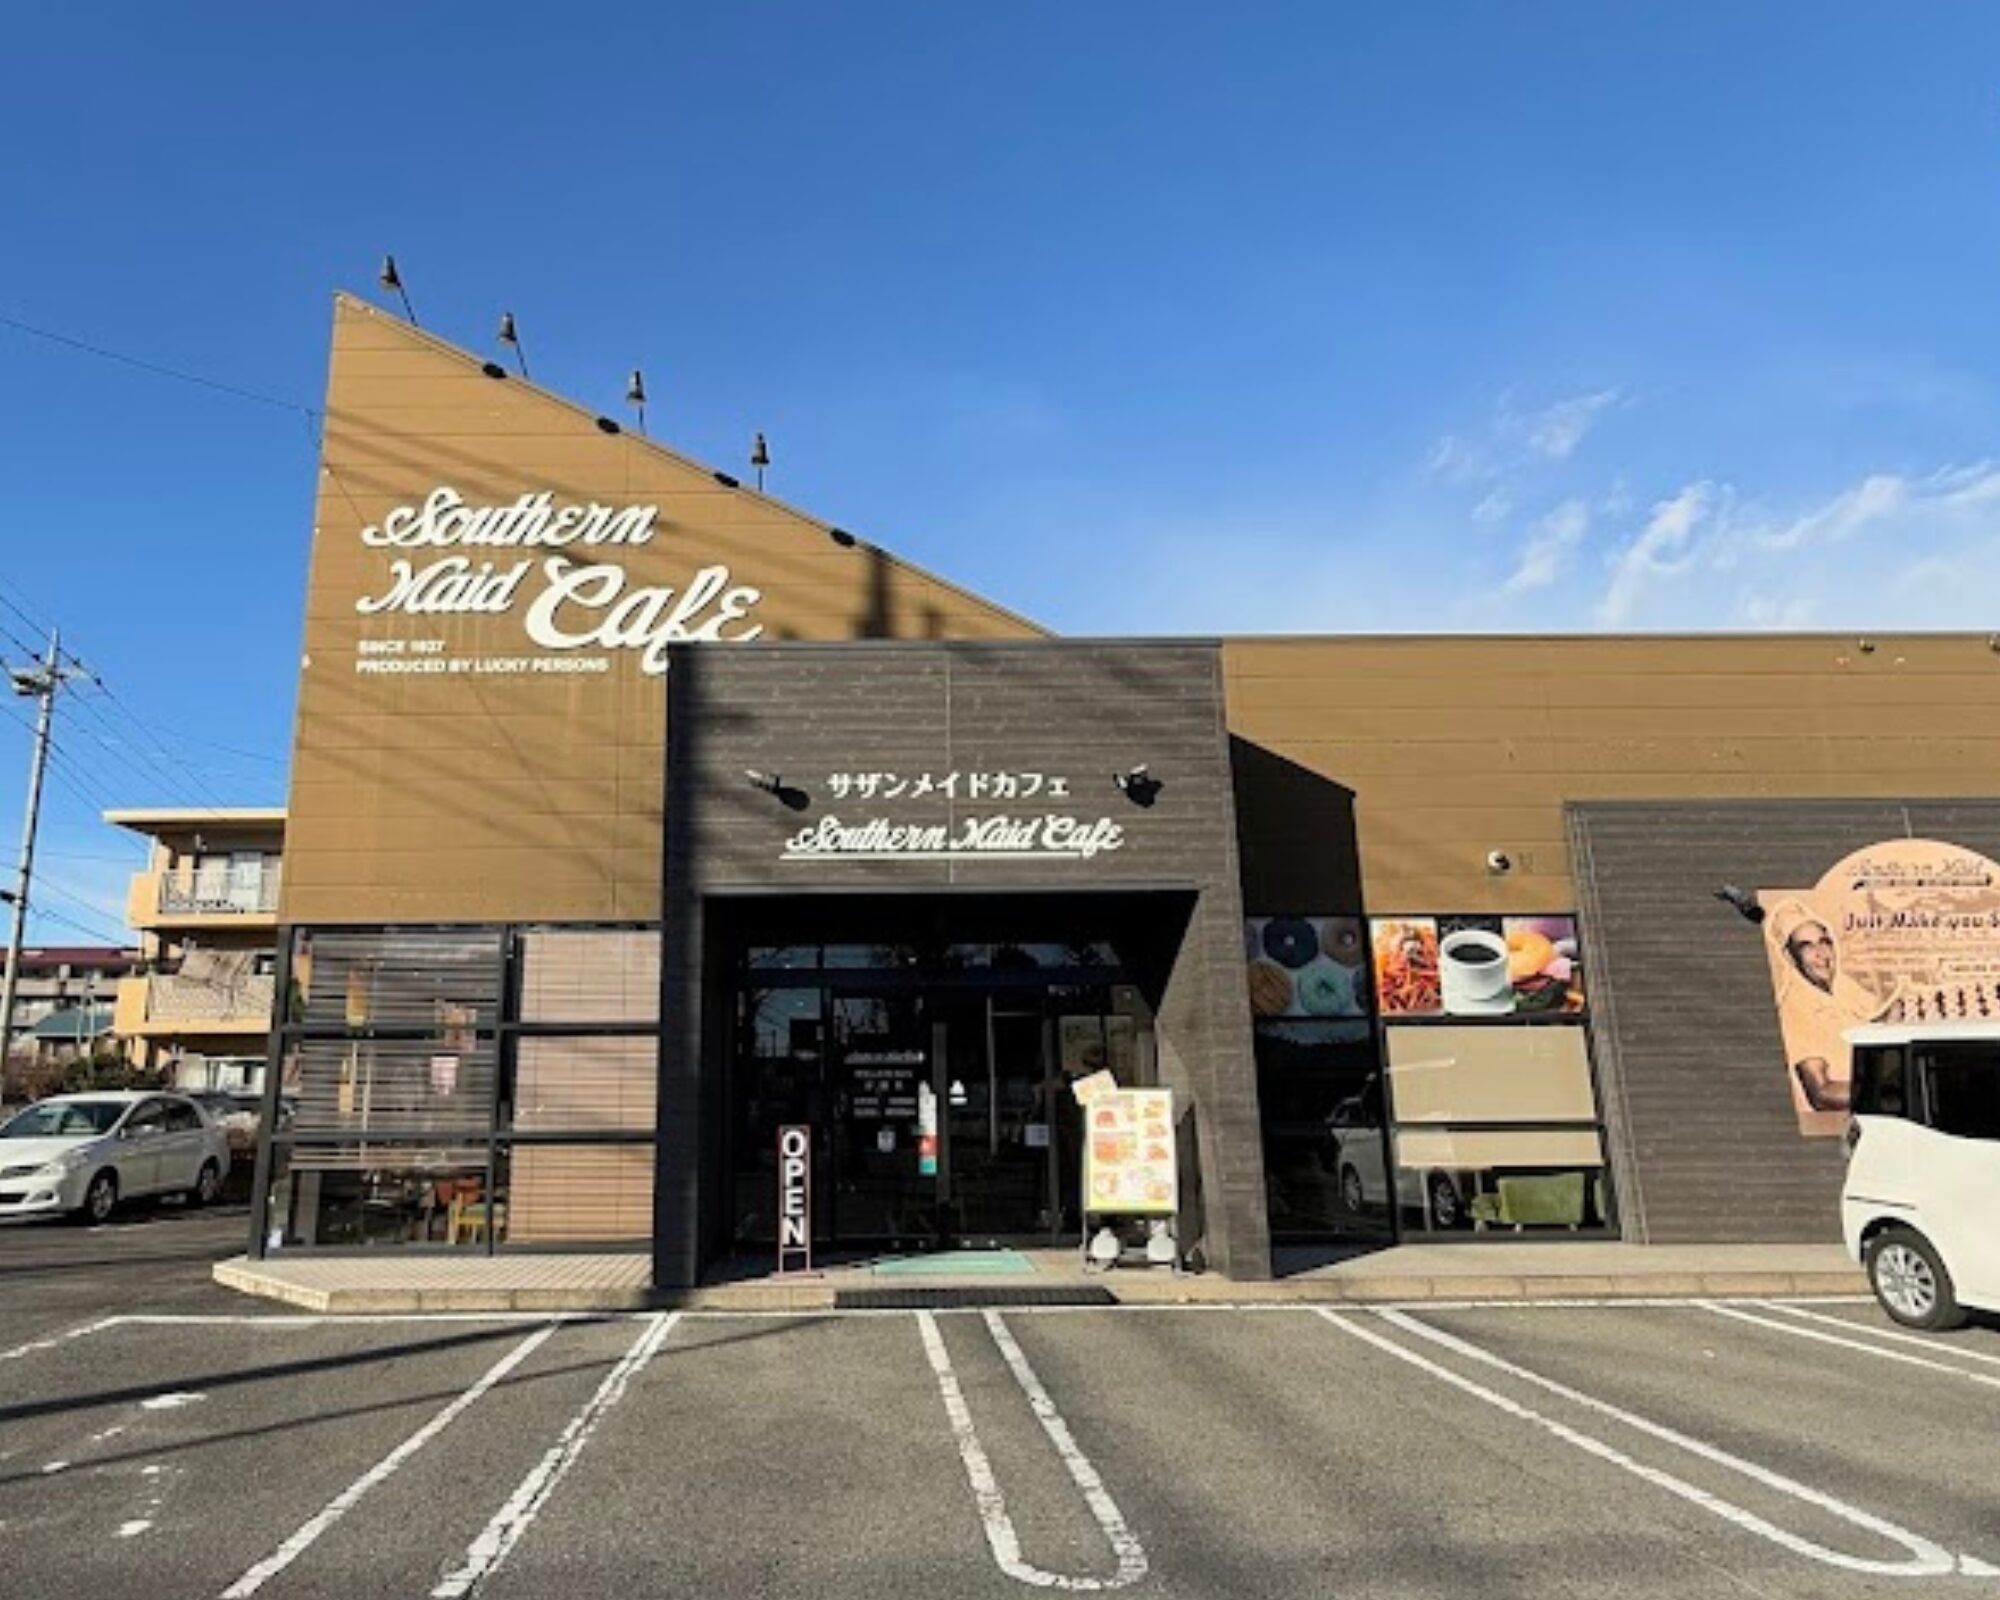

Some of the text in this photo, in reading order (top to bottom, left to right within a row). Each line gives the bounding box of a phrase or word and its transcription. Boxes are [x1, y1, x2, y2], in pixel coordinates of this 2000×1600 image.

[361, 486, 659, 547] Southern
[356, 556, 764, 674] Maid Cafe
[356, 656, 609, 673] PRODUCED BY LUCKY PERSONS
[358, 640, 405, 654] SINCE
[827, 771, 1070, 798] サザンメイドカフェ
[785, 813, 1125, 858] Southern Maid Cafe
[782, 1131, 806, 1246] OPEN
